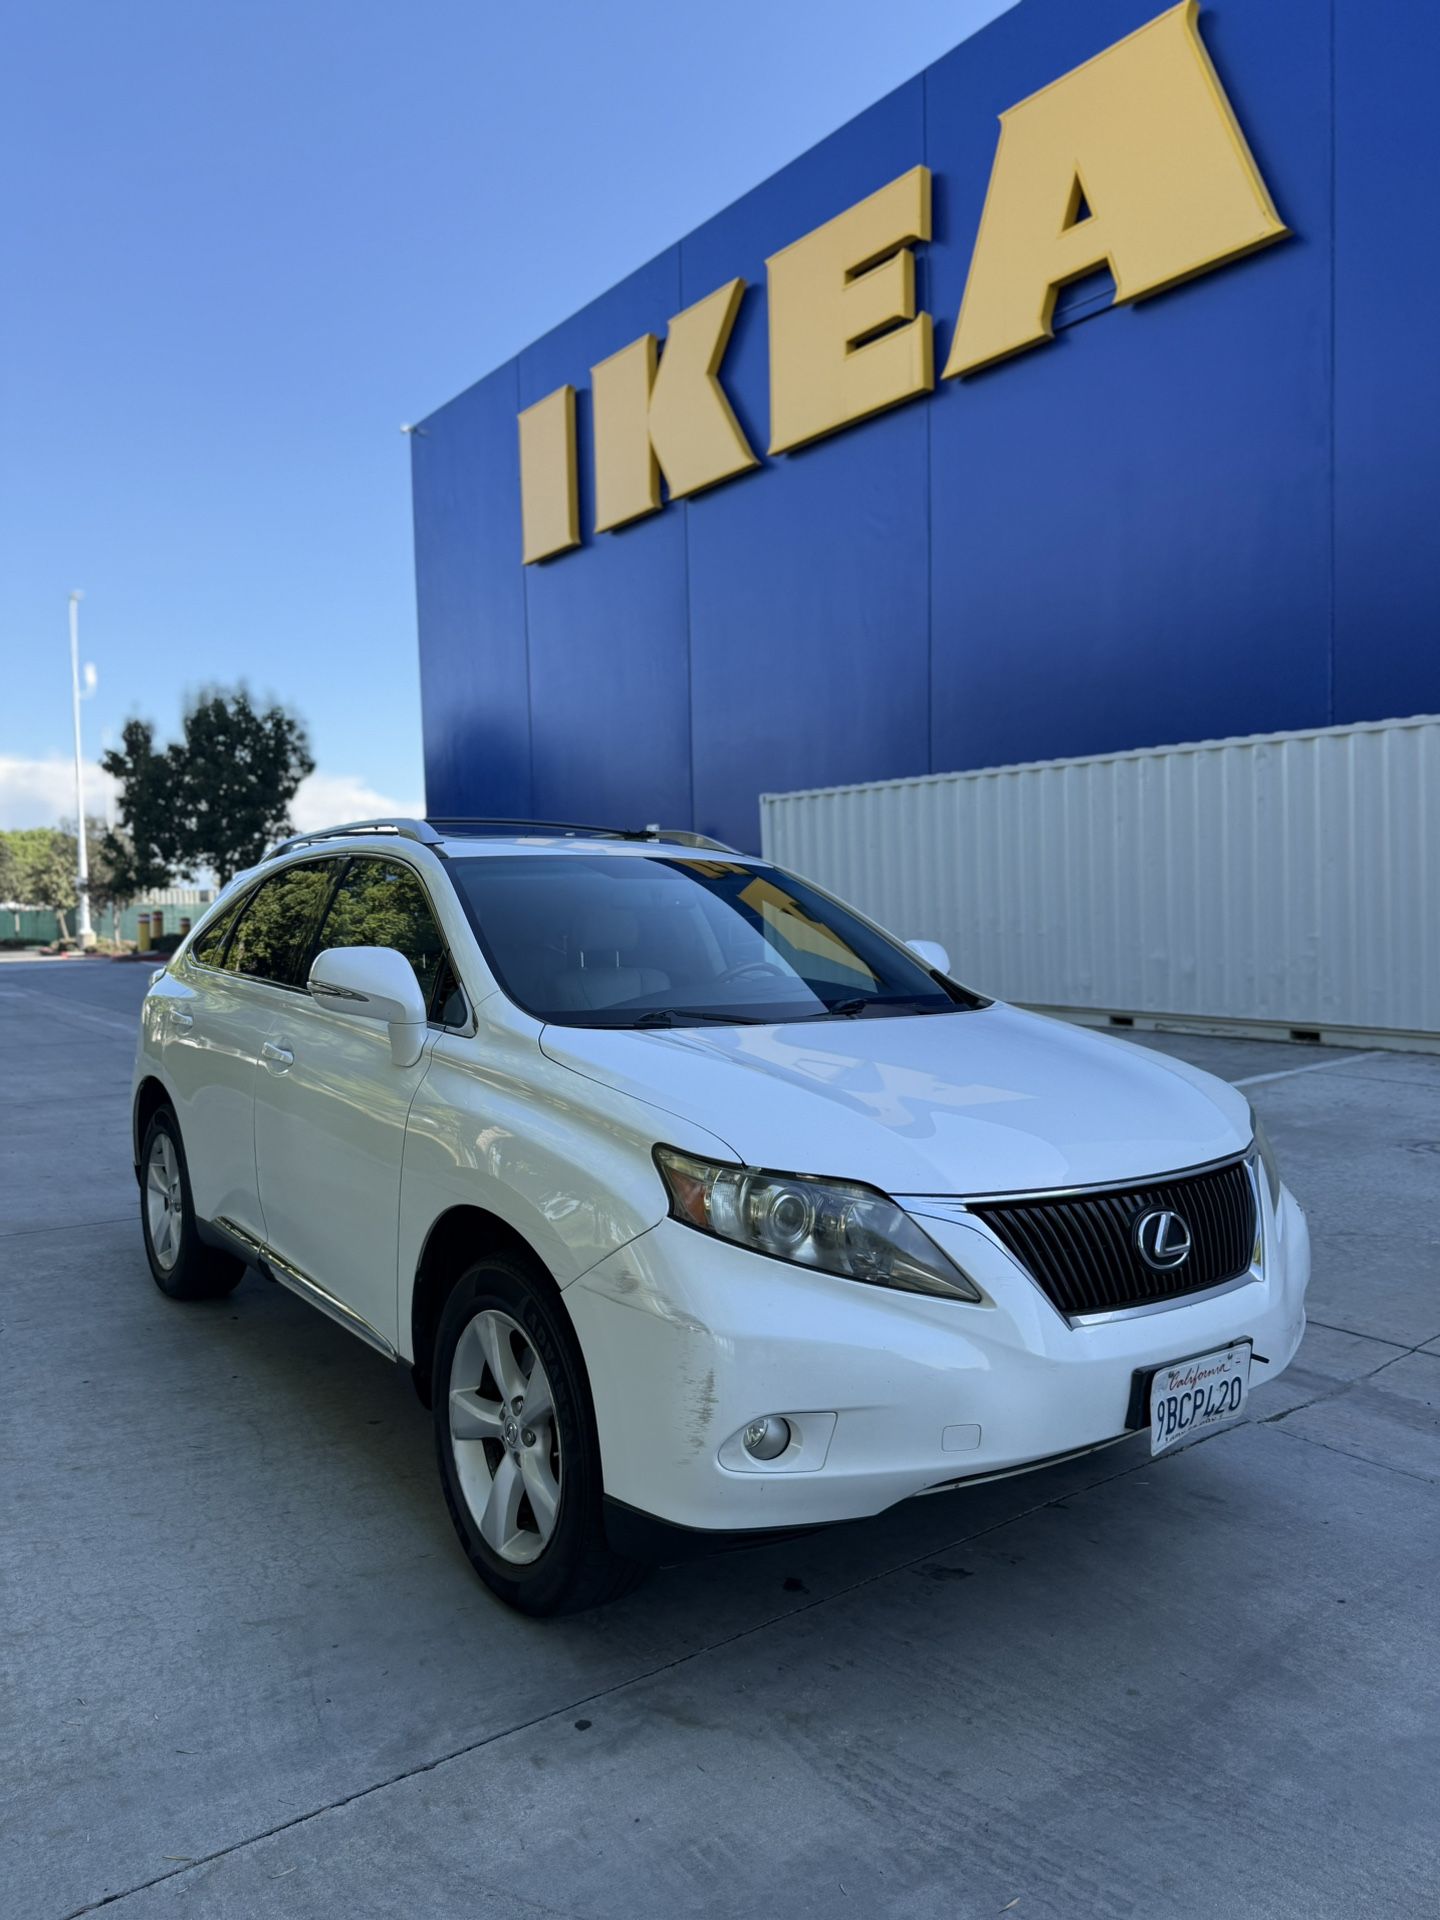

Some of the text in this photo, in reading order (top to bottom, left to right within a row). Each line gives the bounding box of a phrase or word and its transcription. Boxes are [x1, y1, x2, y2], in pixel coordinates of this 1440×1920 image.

[518, 0, 1293, 567] IKEA
[1157, 1376, 1242, 1443] 9BCP420
[1169, 1364, 1231, 1390] California
